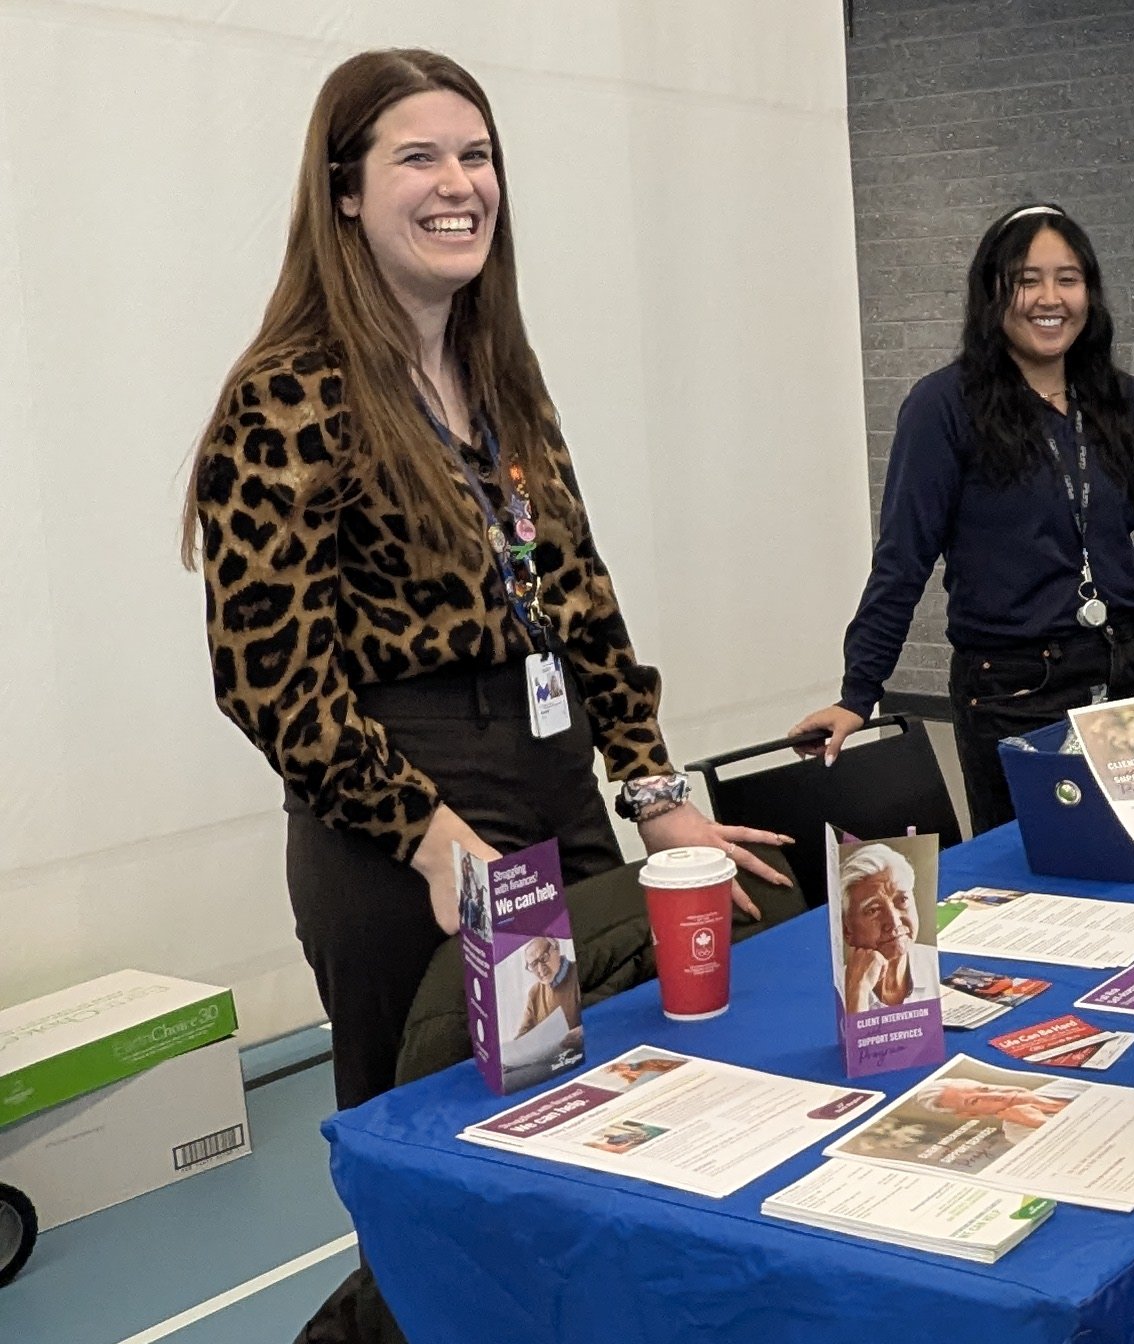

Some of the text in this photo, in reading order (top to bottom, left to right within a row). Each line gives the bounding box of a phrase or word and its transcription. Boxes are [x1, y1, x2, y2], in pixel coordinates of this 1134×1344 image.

[493, 863, 527, 883] Struggling
[494, 870, 539, 896] with finances?
[495, 882, 559, 917] We can help.
[199, 1004, 219, 1023] 30
[856, 1016, 880, 1030] CLIENT
[881, 1007, 930, 1025] INTERVENTION
[857, 1027, 924, 1049] SUPPORT SERVICES
[999, 1038, 1020, 1049] Life
[1019, 1032, 1041, 1043] Can
[1052, 1019, 1079, 1033] Hard
[509, 1098, 591, 1134] We can help.
